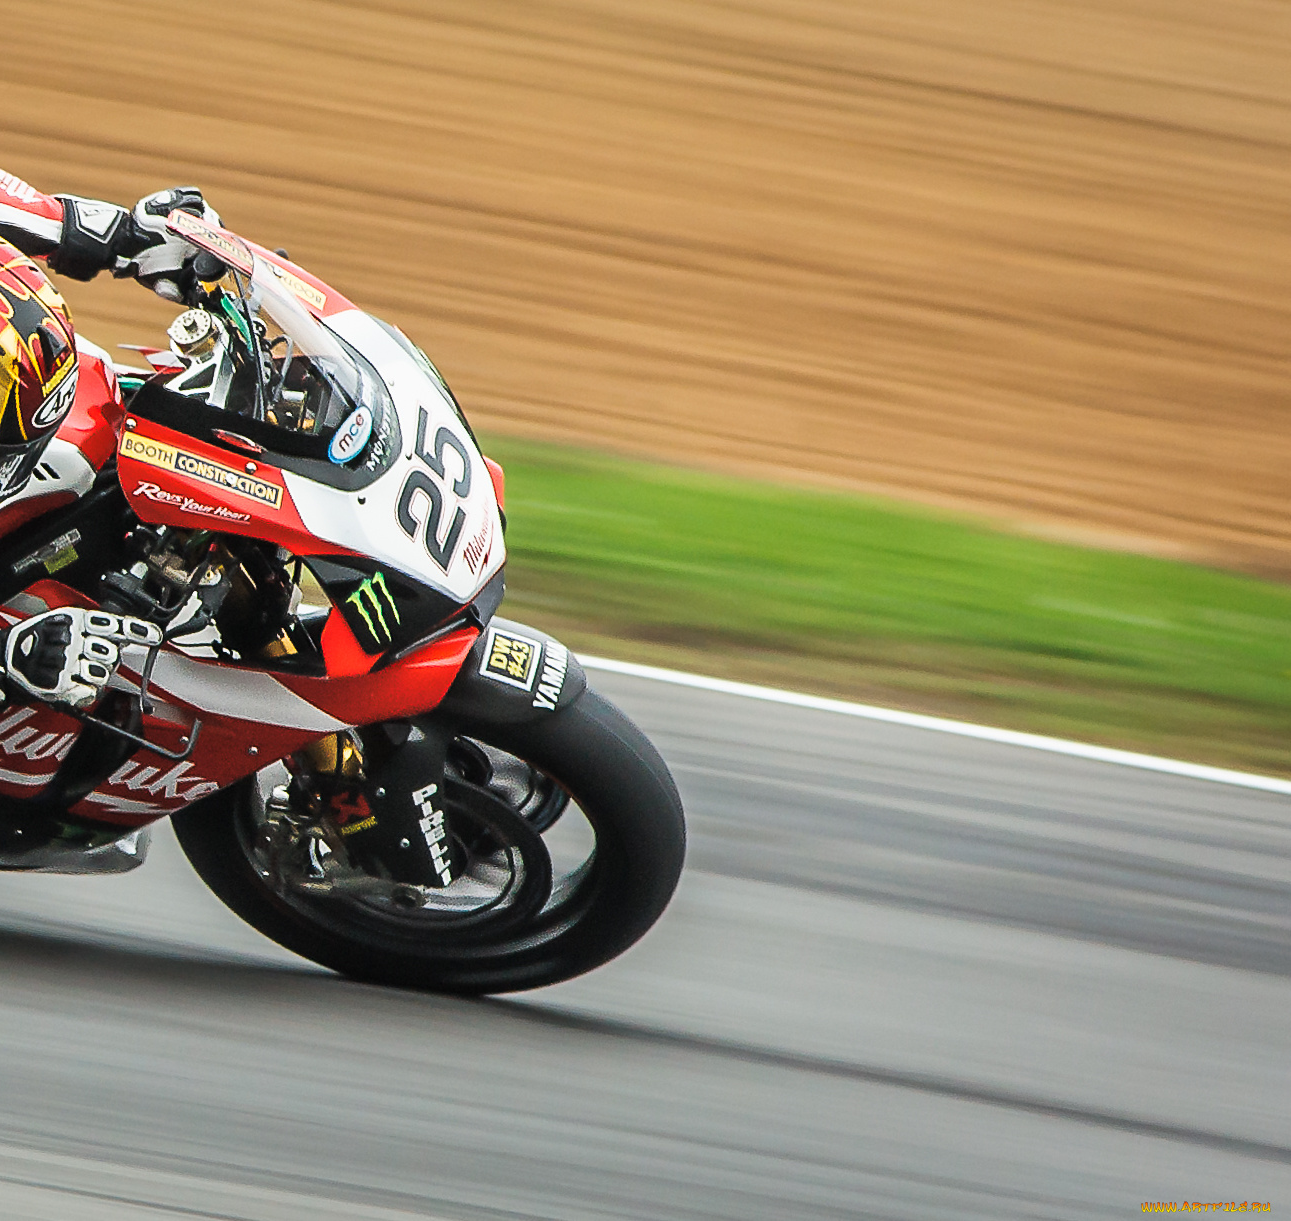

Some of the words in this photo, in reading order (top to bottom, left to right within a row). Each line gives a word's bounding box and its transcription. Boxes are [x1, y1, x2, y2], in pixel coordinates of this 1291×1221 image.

[124, 438, 173, 464] BOOTH
[177, 456, 277, 502] CONSTRCTION
[396, 405, 472, 573] 25
[489, 635, 512, 670] DW
[507, 640, 530, 678] #43
[411, 783, 454, 887] PIRELLI
